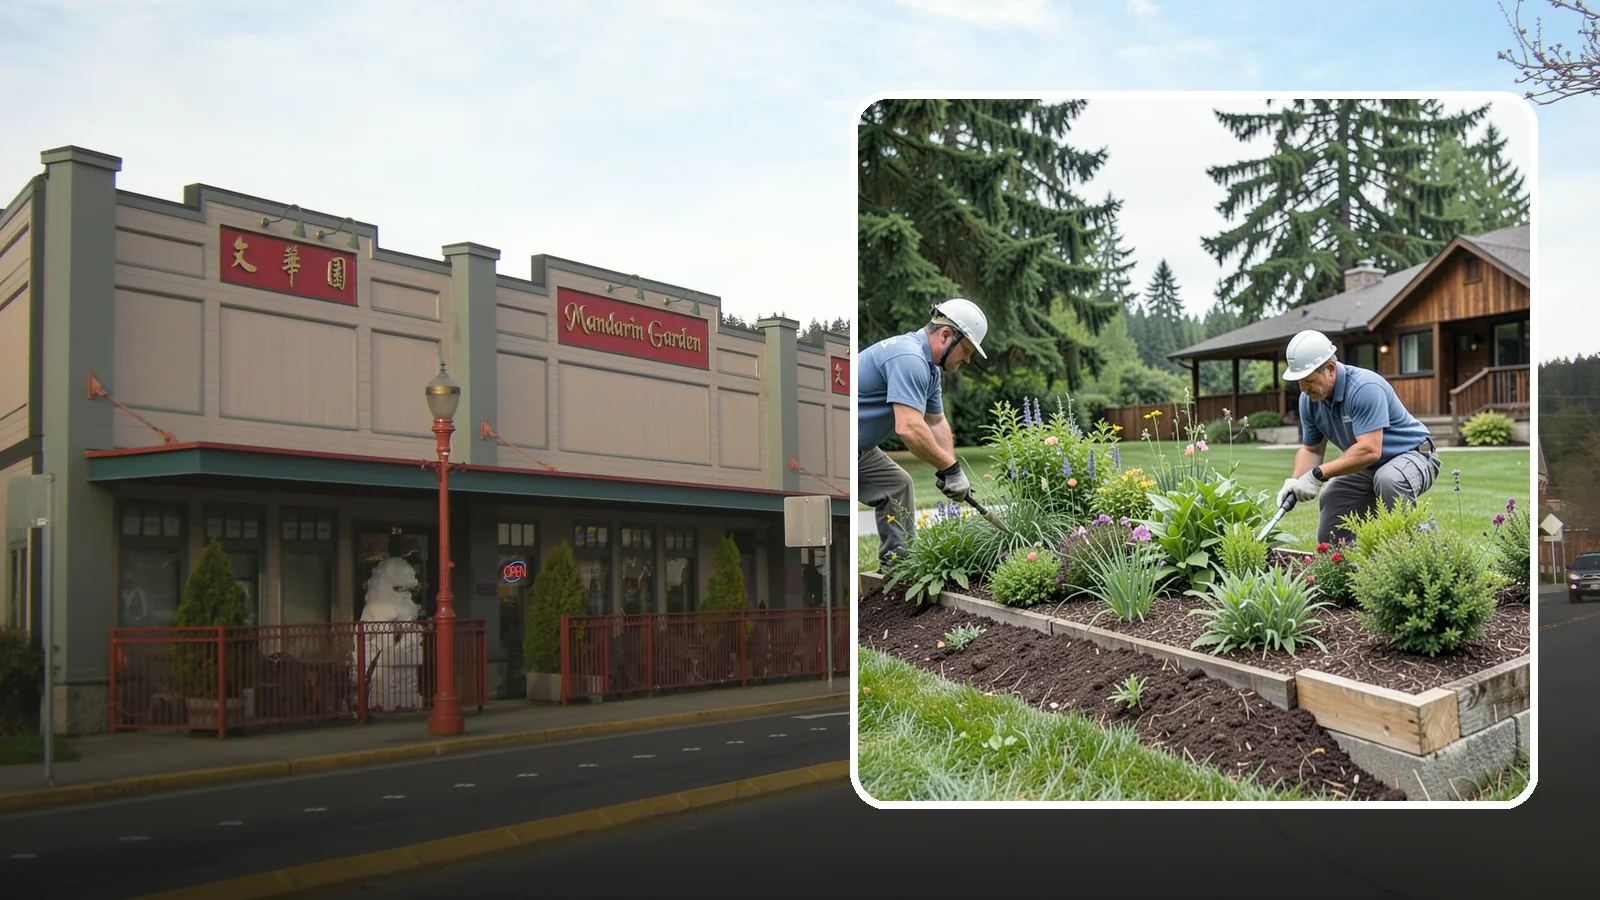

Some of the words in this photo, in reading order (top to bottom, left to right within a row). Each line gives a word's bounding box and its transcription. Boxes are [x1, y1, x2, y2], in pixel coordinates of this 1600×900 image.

[231, 236, 346, 290] 文華園
[565, 302, 643, 340] Mandarin
[648, 320, 701, 351] Garden
[503, 565, 526, 578] OPEN
